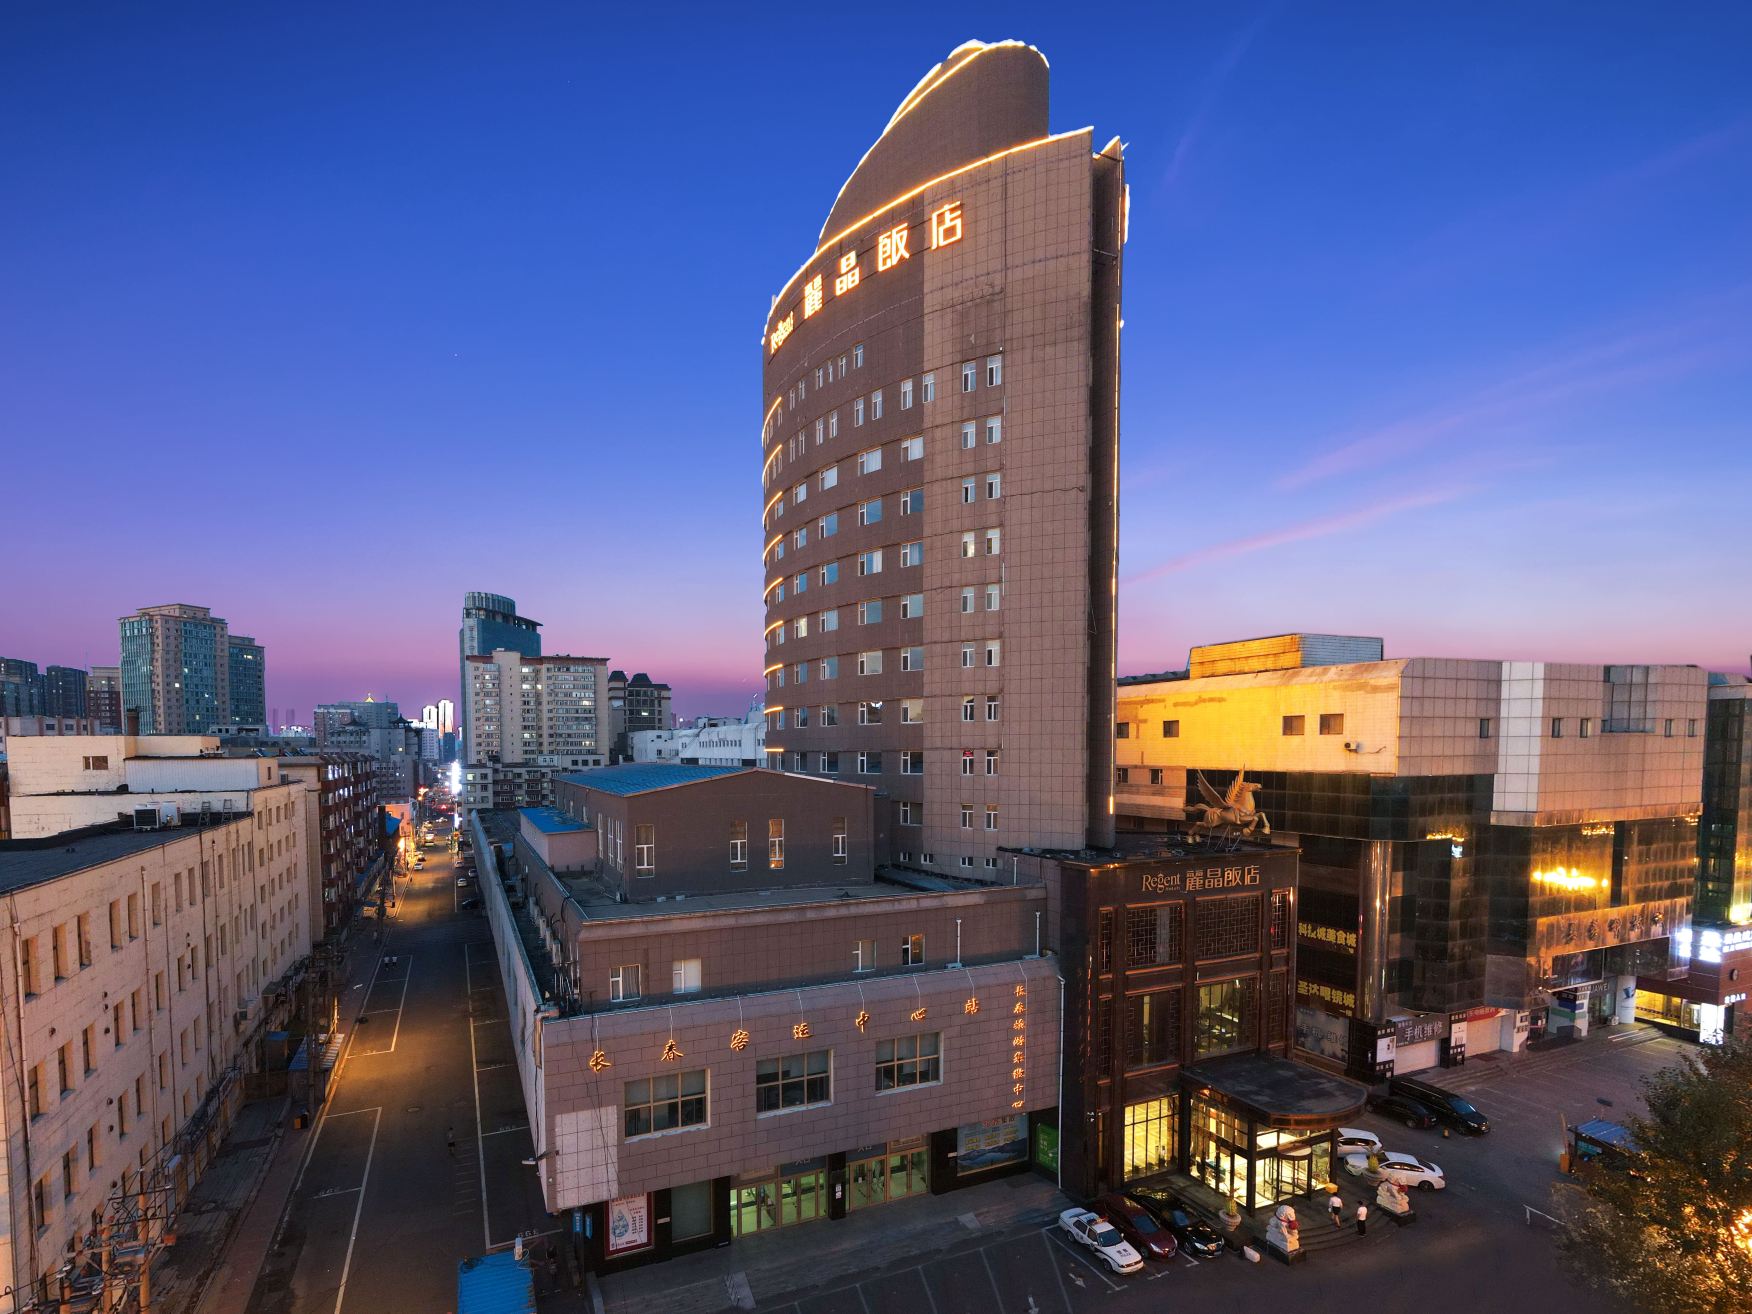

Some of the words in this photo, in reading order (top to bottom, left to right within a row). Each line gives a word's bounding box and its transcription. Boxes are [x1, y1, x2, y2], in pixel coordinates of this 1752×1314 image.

[804, 200, 963, 320] 麗晶飯店
[1142, 872, 1181, 893] Regent
[1185, 864, 1260, 891] 麗晶飯店
[1297, 980, 1355, 1009] 圣达眼镜城
[589, 997, 980, 1074] 长春客运中心站
[1011, 985, 1026, 1108] 长春旅游集散中心
[1404, 1020, 1443, 1041] 手机维修
